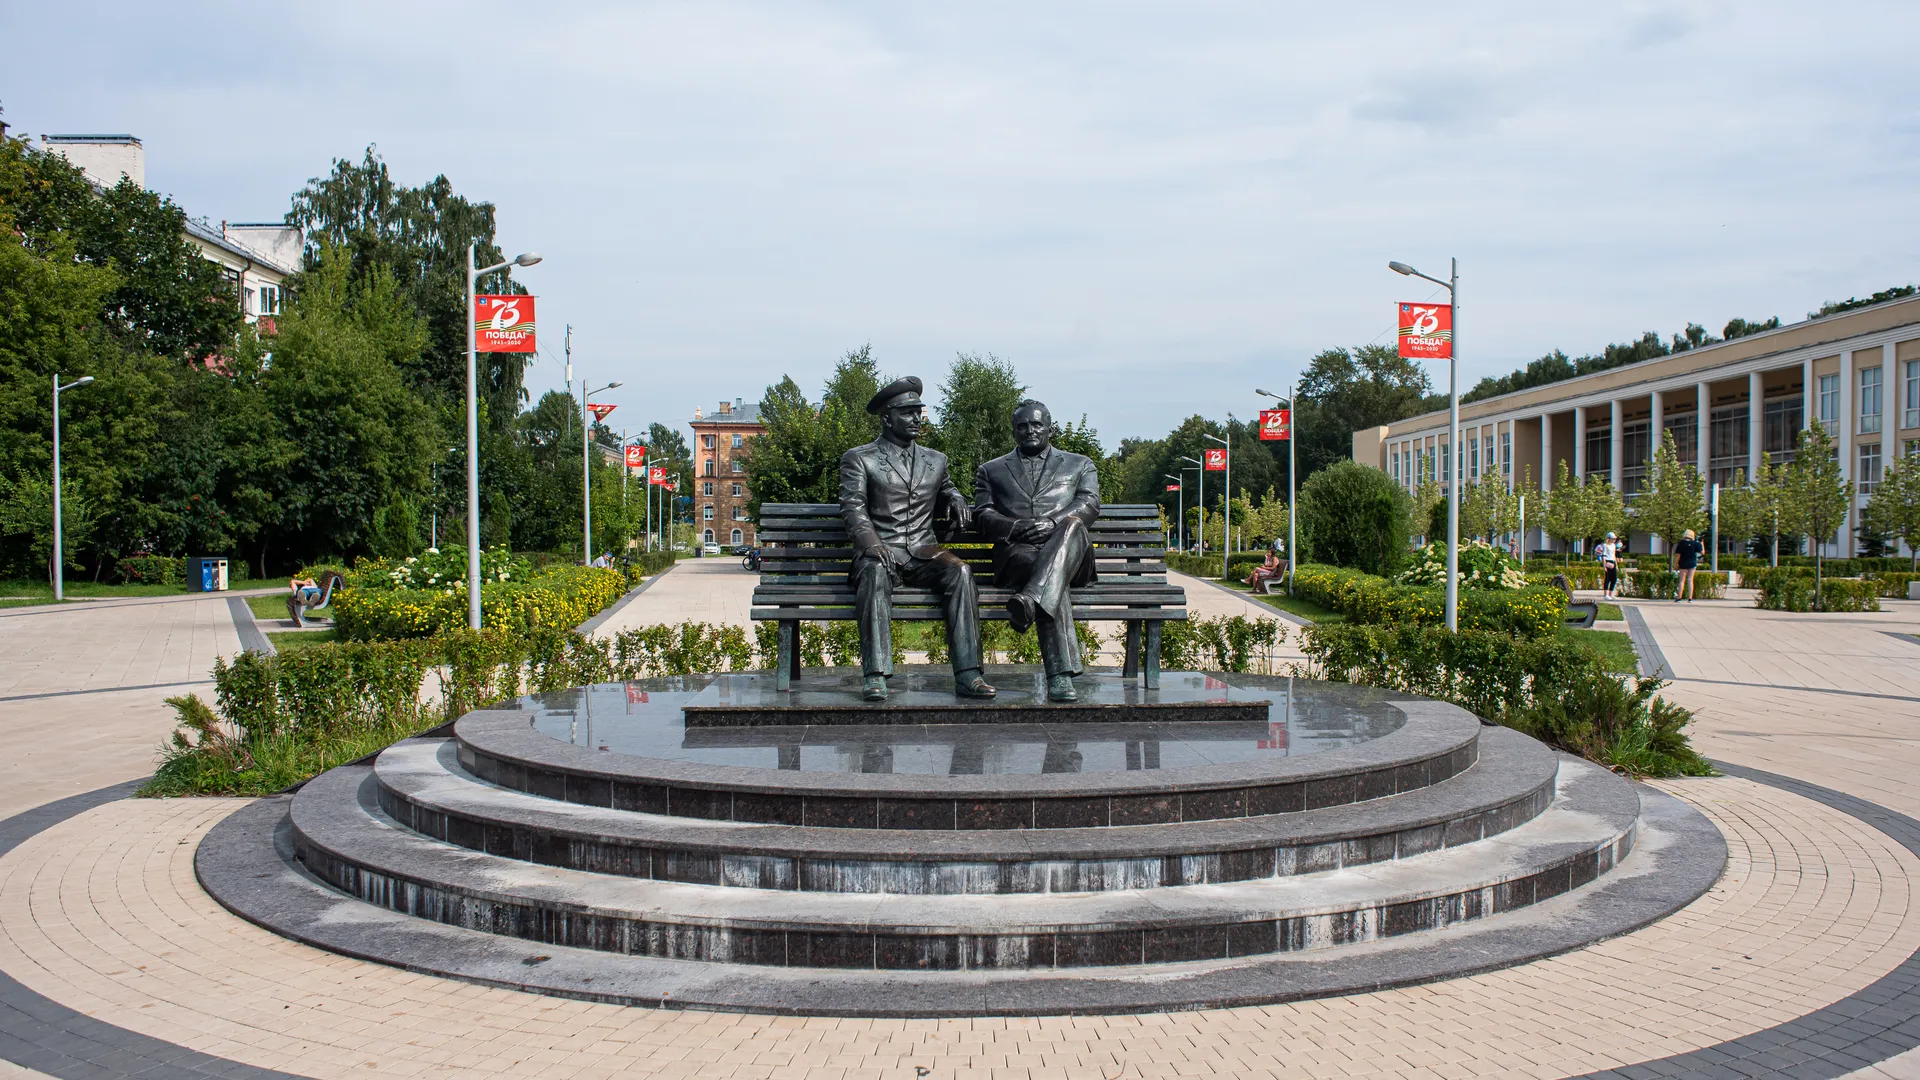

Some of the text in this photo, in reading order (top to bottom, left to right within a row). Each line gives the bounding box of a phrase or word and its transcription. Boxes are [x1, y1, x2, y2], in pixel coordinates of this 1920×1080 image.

[491, 298, 520, 329] 75
[1413, 306, 1438, 336] 75
[486, 332, 526, 340] ПОБЕДА!
[1407, 337, 1443, 346] ПОБЕДА!
[1266, 412, 1282, 428] 75
